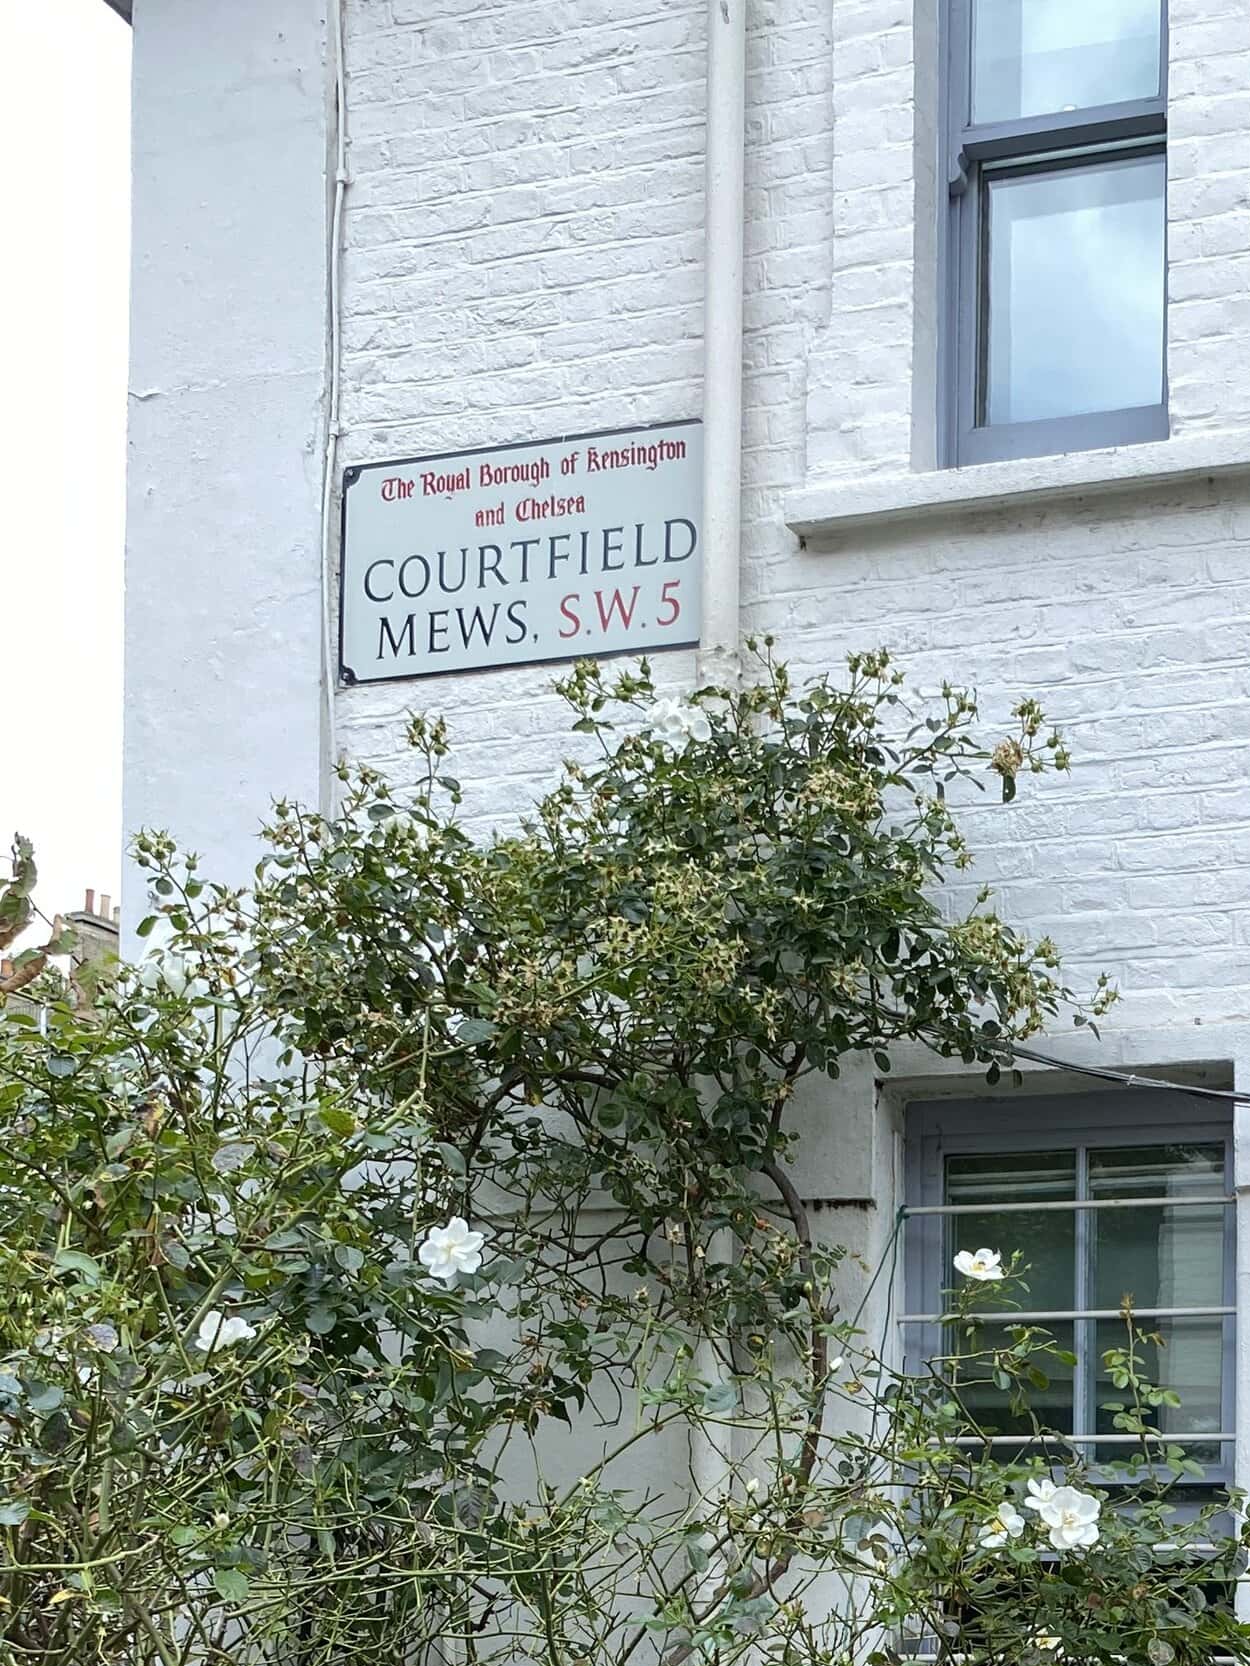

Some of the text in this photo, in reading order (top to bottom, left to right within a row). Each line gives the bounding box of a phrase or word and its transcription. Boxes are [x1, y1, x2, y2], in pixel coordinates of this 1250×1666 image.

[381, 439, 686, 502] The Royal Borough of Kensington
[475, 494, 586, 528] and Chelsea
[363, 518, 698, 603] COURTFIELD
[376, 600, 540, 661] MEWS,
